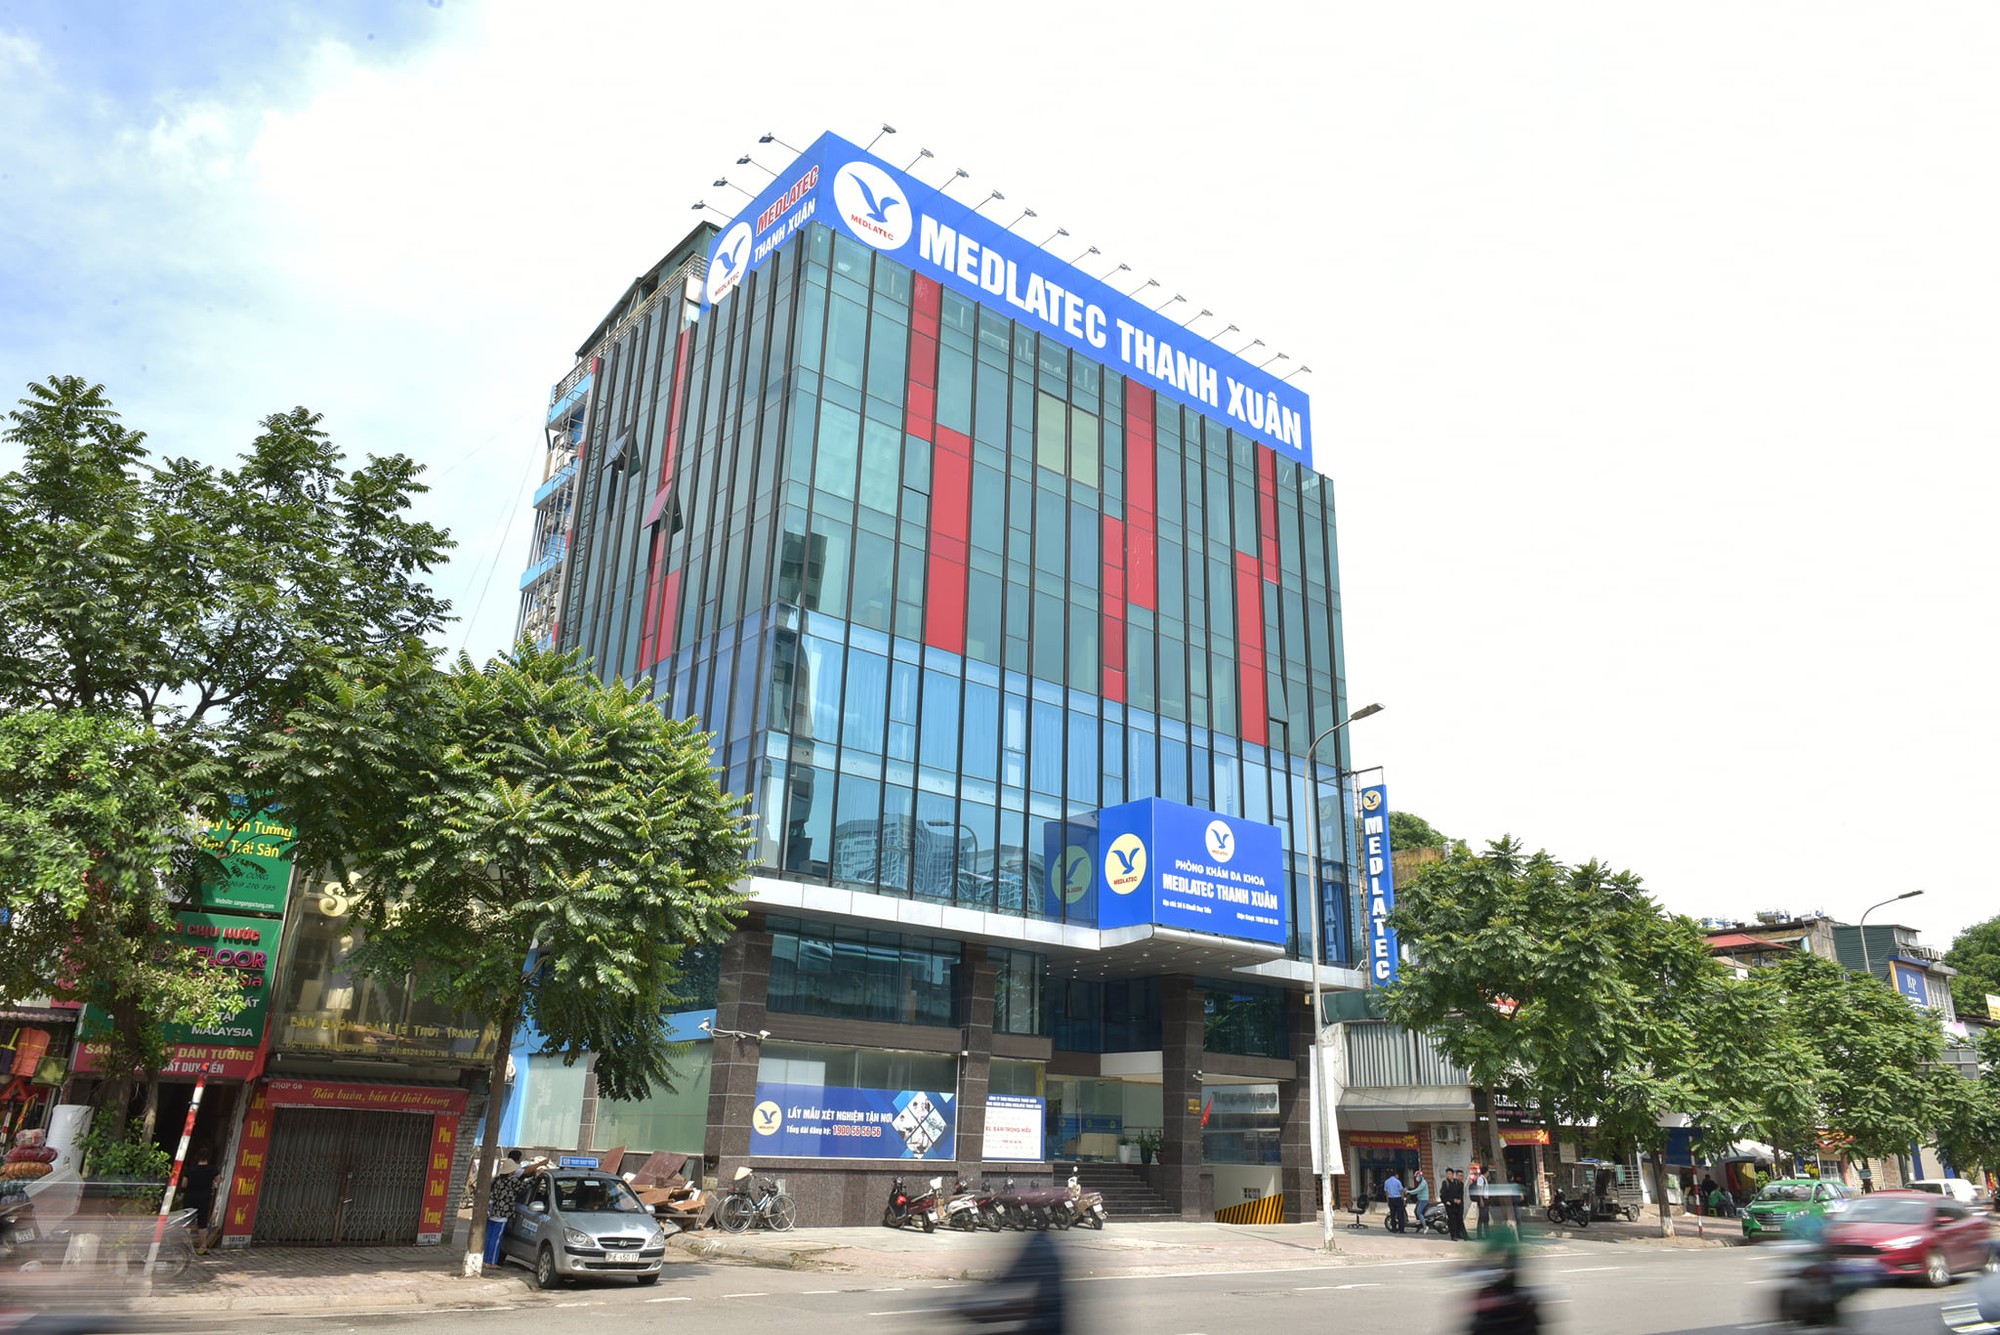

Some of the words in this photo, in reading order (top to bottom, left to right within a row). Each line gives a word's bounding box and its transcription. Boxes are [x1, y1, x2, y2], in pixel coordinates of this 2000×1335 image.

[756, 165, 818, 236] MEDLATEC
[754, 224, 786, 262] THANH
[788, 198, 816, 235] XUÂN
[850, 214, 894, 240] MEDLATEC
[919, 213, 1107, 349] MEDLATEC
[1116, 318, 1218, 408] THANH
[1226, 376, 1302, 450] XUÂN
[254, 820, 293, 841] Tường
[1113, 876, 1138, 886] MEDLATEC
[1175, 859, 1204, 874] PHÒNG
[1206, 866, 1228, 880] KHÁM
[1230, 871, 1242, 882] ĐA
[1243, 873, 1266, 886] KHOA
[1162, 873, 1214, 898] MEDLATEC
[1216, 884, 1249, 904] THANH
[1251, 890, 1278, 910] XUÂN
[1364, 816, 1390, 980] MEDLATEC
[191, 1026, 254, 1037] MALAYSIA
[445, 1026, 480, 1039] TRANG
[210, 1045, 254, 1061] TƯỜNG
[311, 1088, 334, 1099] Bán
[788, 1105, 801, 1118] LẤY
[836, 1110, 864, 1123] NGHIỆM
[866, 1110, 880, 1124] TẬN
[786, 1124, 799, 1134] Tổng
[832, 1124, 850, 1136] 1900
[851, 1125, 860, 1137] 56
[861, 1126, 870, 1137] 56
[871, 1126, 881, 1138] 56
[242, 1148, 263, 1171] Trang
[424, 1207, 442, 1228] Trang
